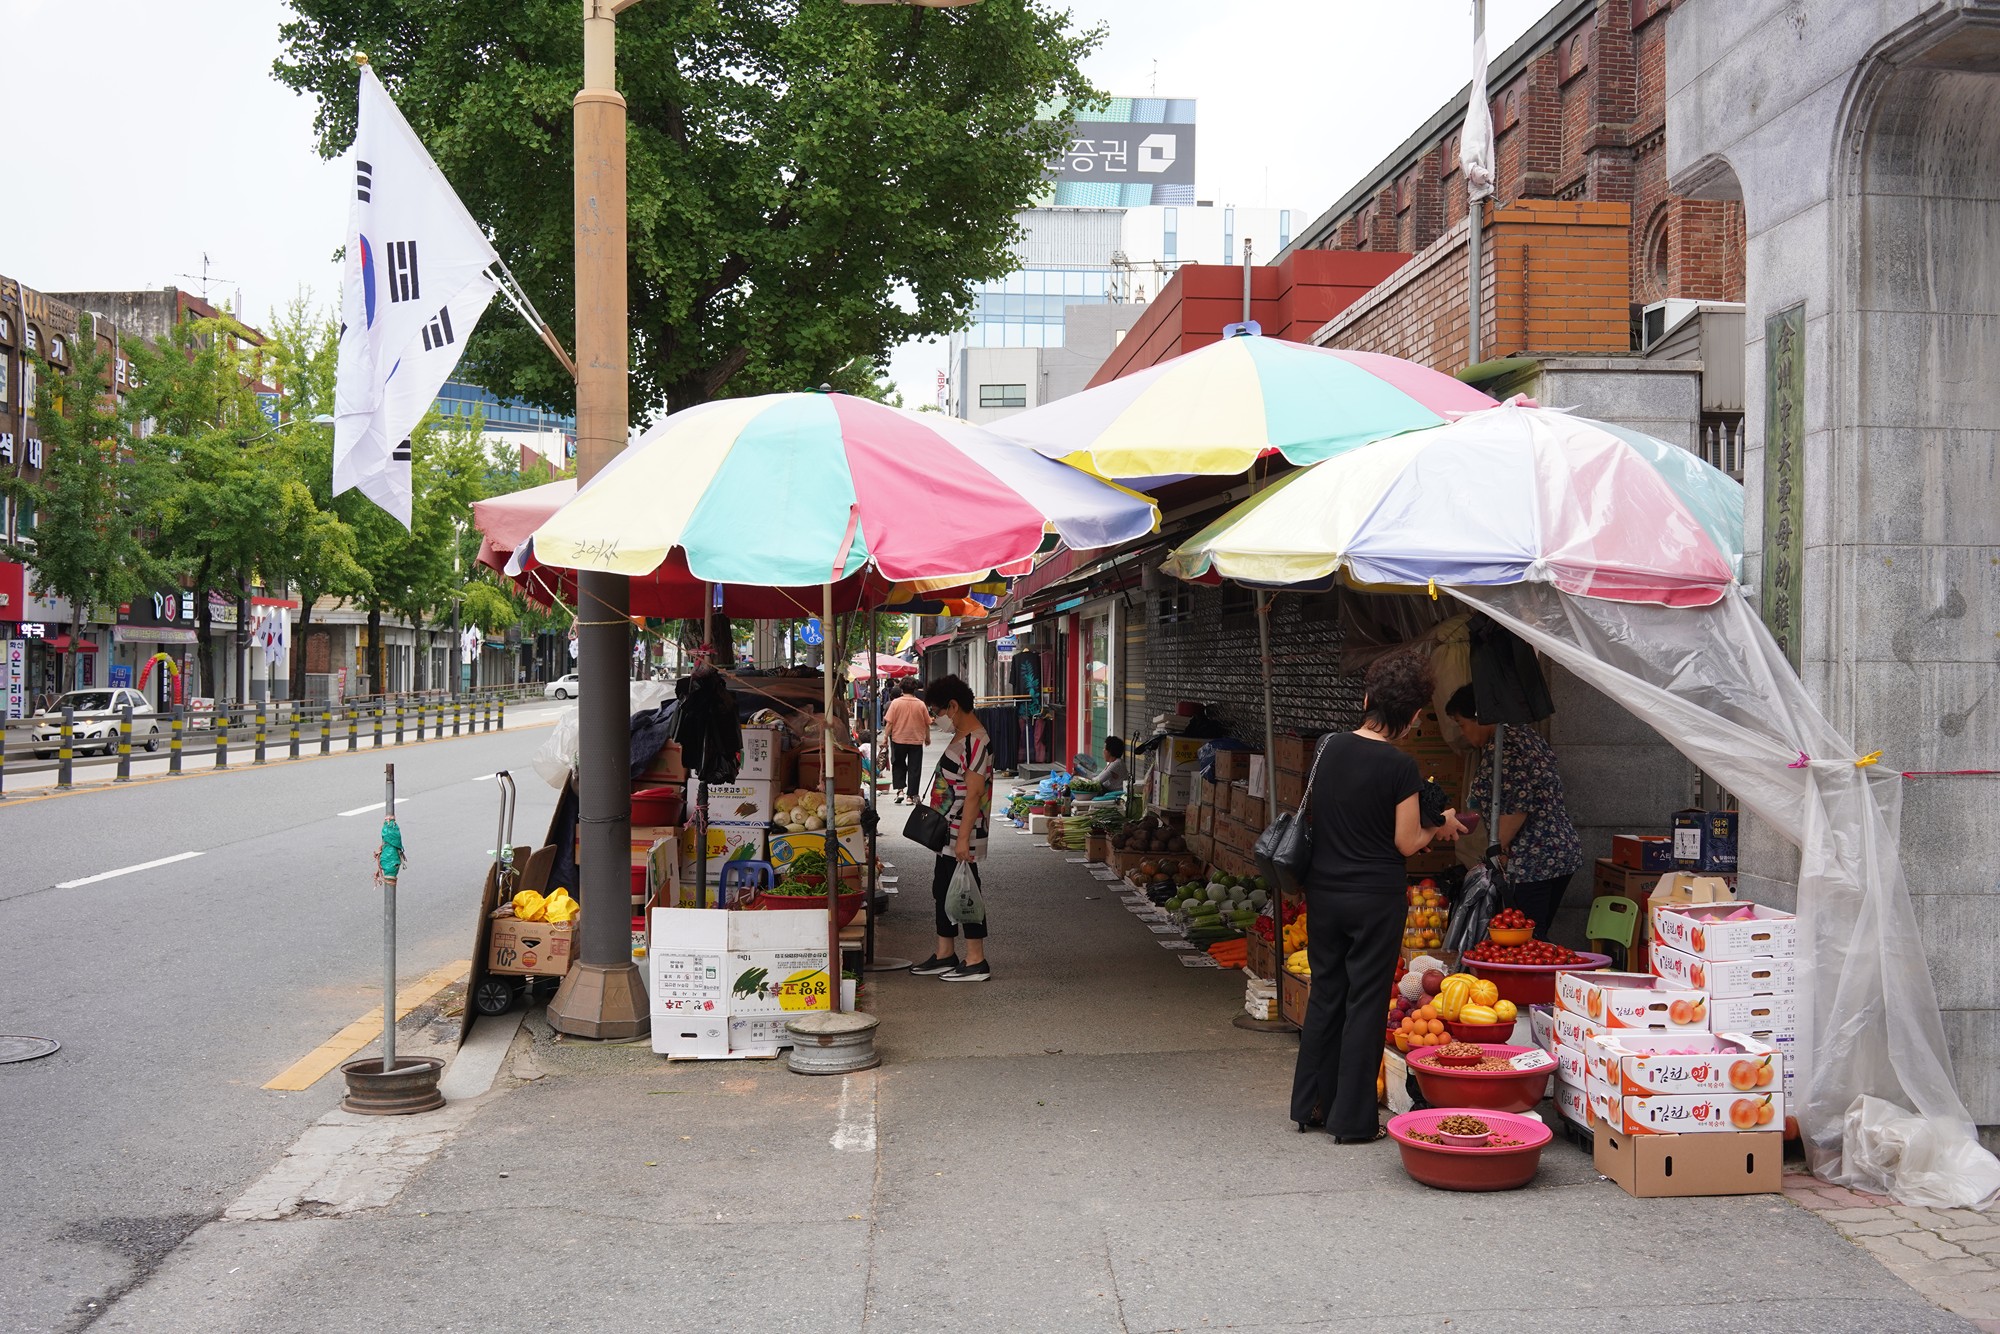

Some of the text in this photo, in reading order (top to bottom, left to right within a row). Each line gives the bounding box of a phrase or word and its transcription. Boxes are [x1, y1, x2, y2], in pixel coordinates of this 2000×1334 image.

[21, 624, 45, 639] 약국
[760, 739, 768, 761] 고추
[769, 981, 828, 997] 청양고추
